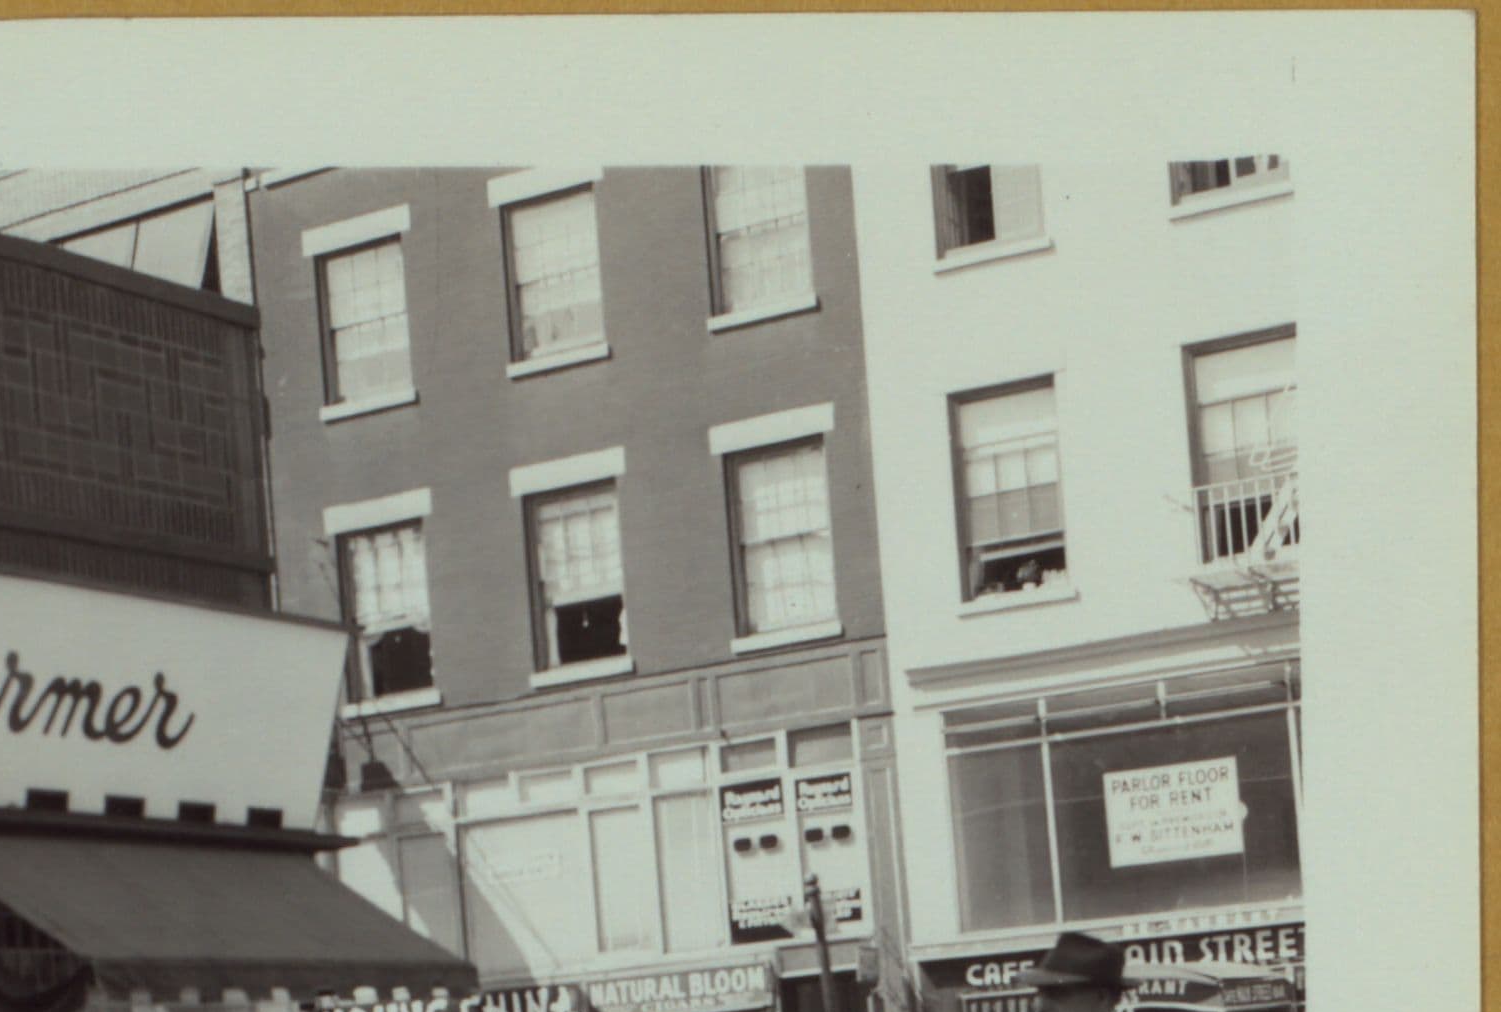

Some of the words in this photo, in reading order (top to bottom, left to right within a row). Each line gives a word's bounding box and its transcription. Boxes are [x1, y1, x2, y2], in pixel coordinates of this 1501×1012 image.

[1111, 774, 1170, 795] PARLOR
[1178, 766, 1229, 785] FLOOR
[1130, 794, 1160, 810] FOR
[1169, 787, 1212, 806] RENT
[1199, 928, 1306, 963] STREE
[589, 974, 686, 1007] NATURAL
[688, 966, 766, 1000] BLOOM
